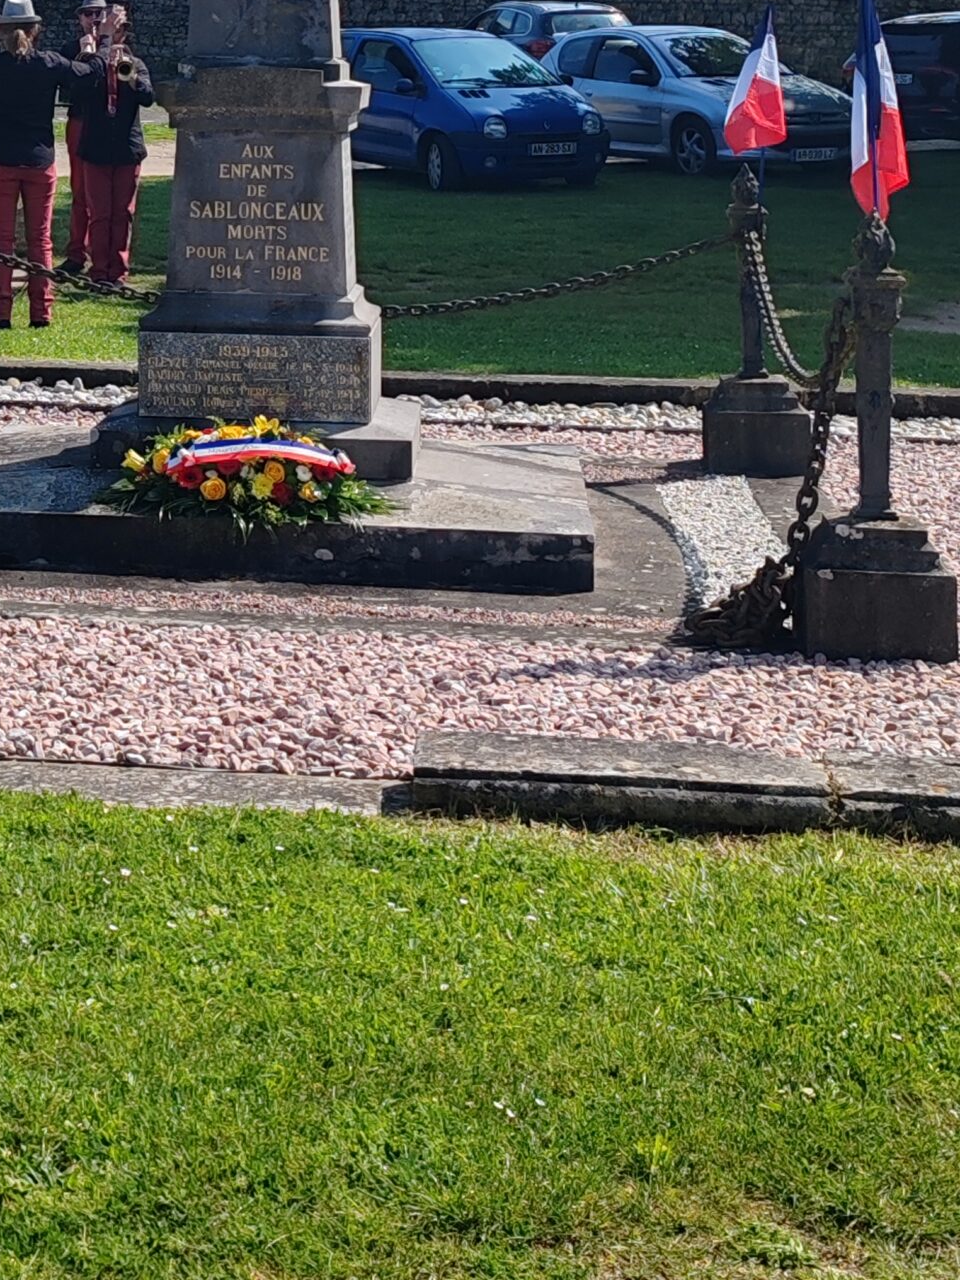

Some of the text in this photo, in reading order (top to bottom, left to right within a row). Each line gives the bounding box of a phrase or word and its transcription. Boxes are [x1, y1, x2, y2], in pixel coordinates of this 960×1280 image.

[241, 143, 274, 159] AUX
[219, 163, 294, 179] ENFANTS
[247, 184, 267, 197] DE
[189, 200, 324, 222] SABLONCEAUX
[227, 224, 287, 240] MORTS
[185, 245, 330, 262] POUR LA FRANCE
[210, 264, 242, 279] 1914
[270, 266, 302, 281] 1918
